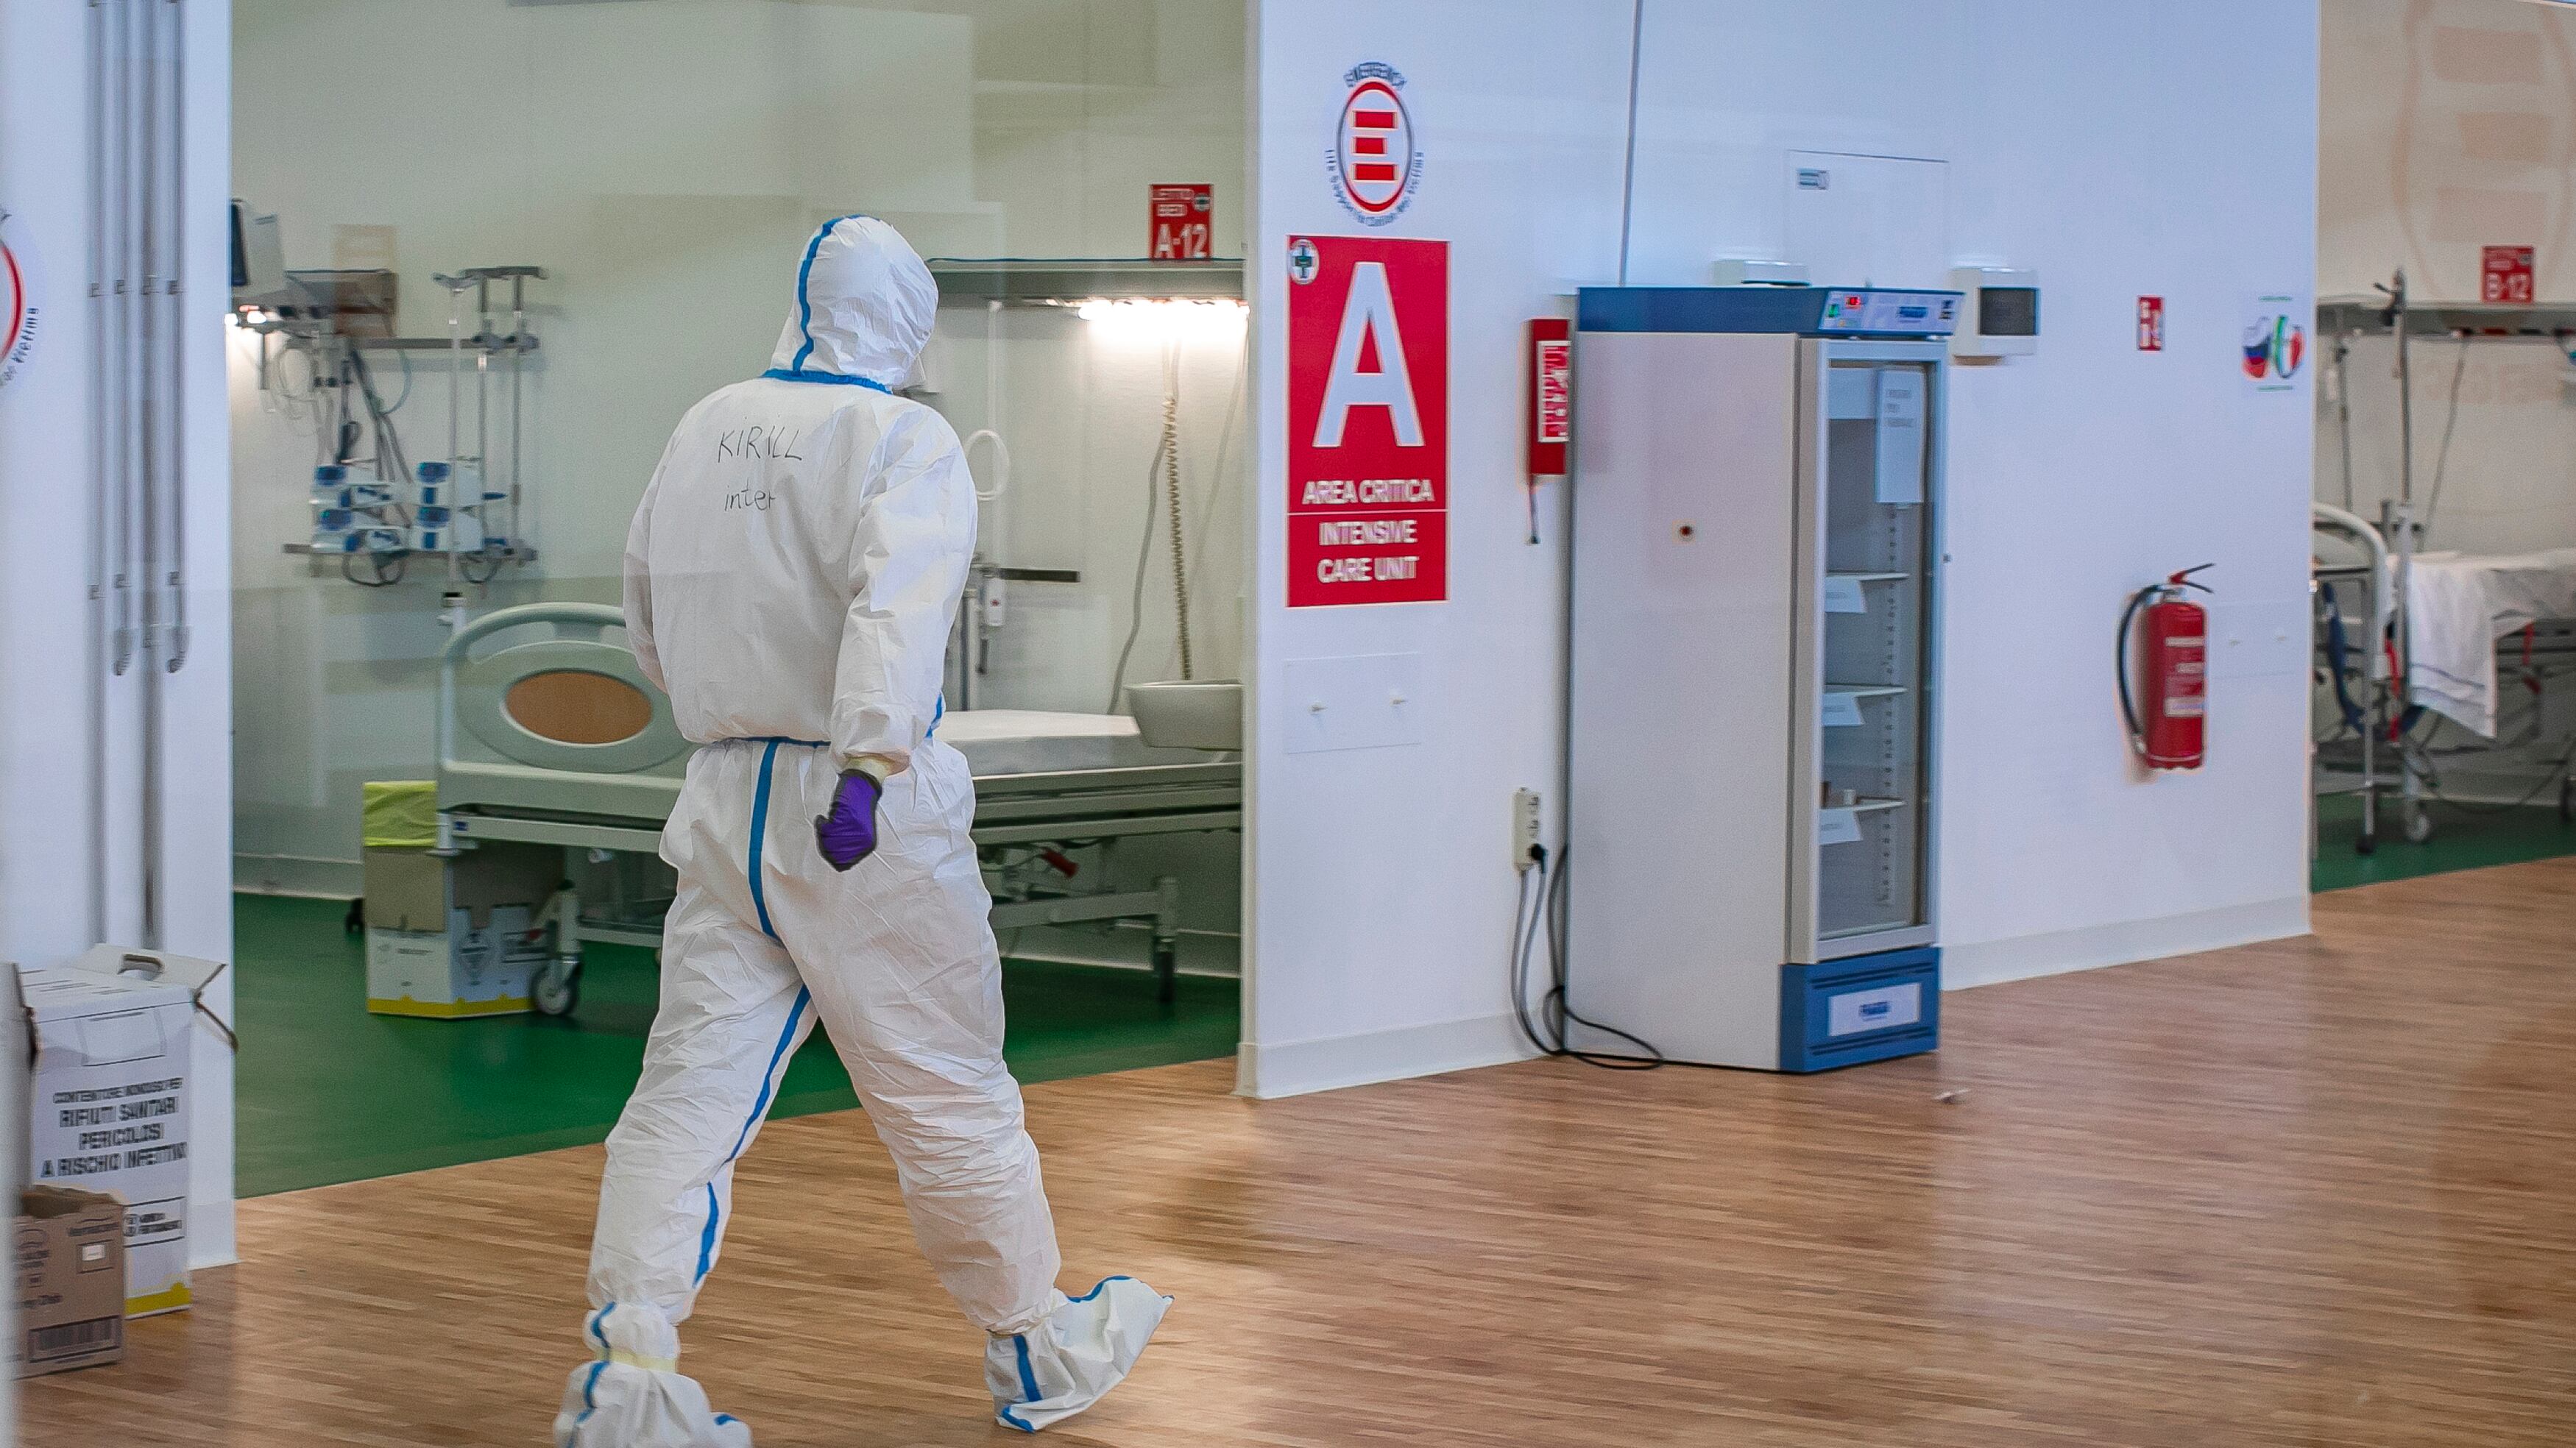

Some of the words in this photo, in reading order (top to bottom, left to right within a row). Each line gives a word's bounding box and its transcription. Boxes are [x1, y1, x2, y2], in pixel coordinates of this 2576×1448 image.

[1154, 223, 1208, 259] A-12
[1312, 262, 1426, 447] A
[718, 425, 802, 463] KIRILL
[1301, 480, 1359, 505] AREA
[1359, 479, 1435, 503] CRITICA
[1318, 520, 1418, 545] INTENSIVE
[1317, 558, 1373, 583] CARE
[1373, 556, 1419, 581] UNIT
[40, 1160, 56, 1178] A
[57, 1153, 121, 1177] RISCHIO
